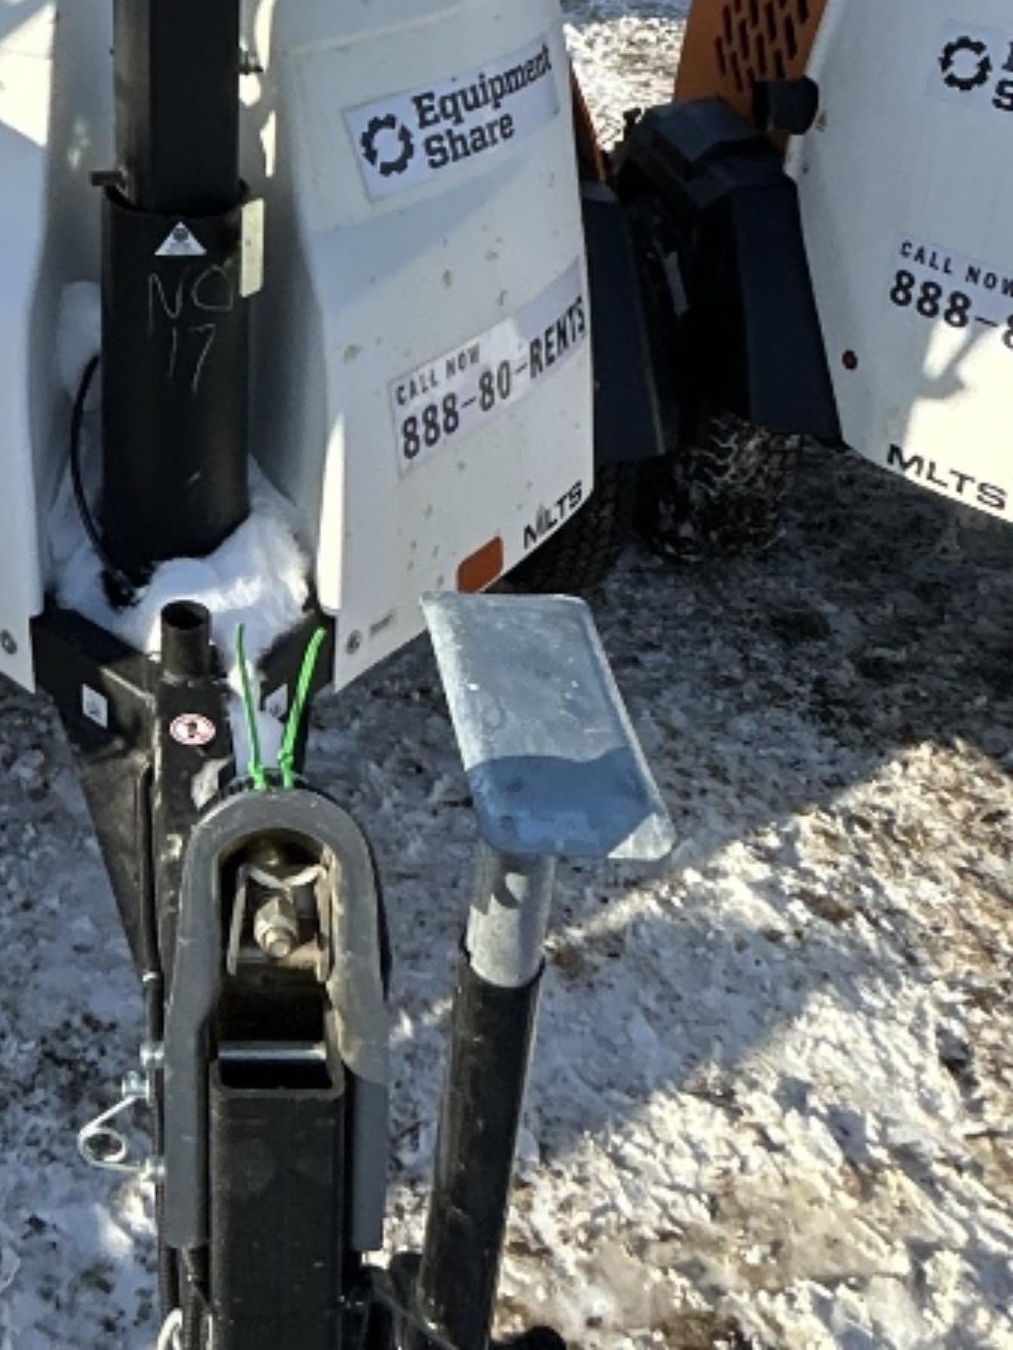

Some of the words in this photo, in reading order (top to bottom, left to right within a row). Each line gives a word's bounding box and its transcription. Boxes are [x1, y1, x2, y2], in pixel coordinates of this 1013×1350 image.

[412, 43, 552, 130] Equipment
[423, 113, 516, 169] Share
[900, 240, 954, 275] CALL
[396, 375, 439, 406] CALL
[446, 342, 480, 380] NOW
[401, 295, 586, 460] 888-80-RENTS
[887, 443, 1007, 510] MLTS
